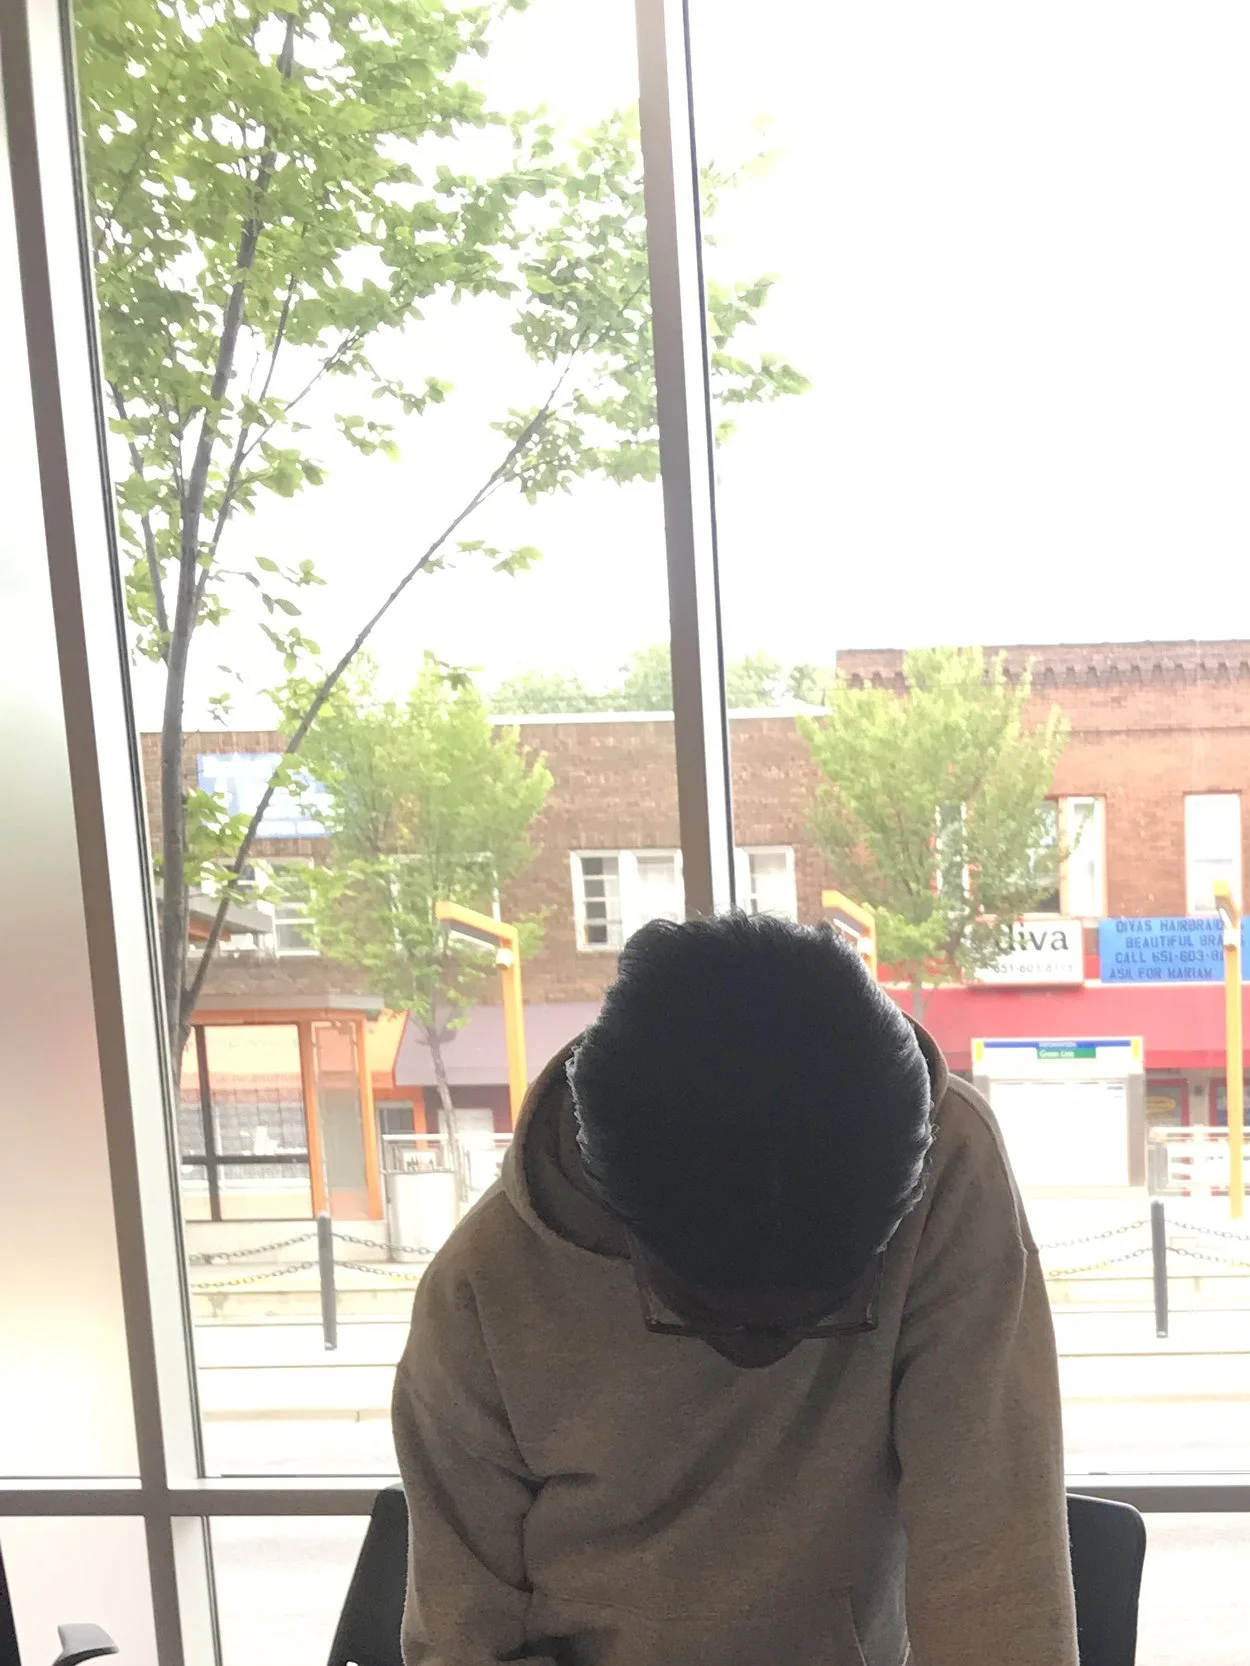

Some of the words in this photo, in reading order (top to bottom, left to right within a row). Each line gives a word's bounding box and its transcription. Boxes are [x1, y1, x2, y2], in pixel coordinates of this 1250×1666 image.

[996, 921, 1069, 951] diva
[1125, 935, 1194, 949] BEAUTIFUL
[1115, 951, 1146, 964] CALL
[1110, 968, 1132, 980] ASK
[1138, 968, 1161, 980] FOR
